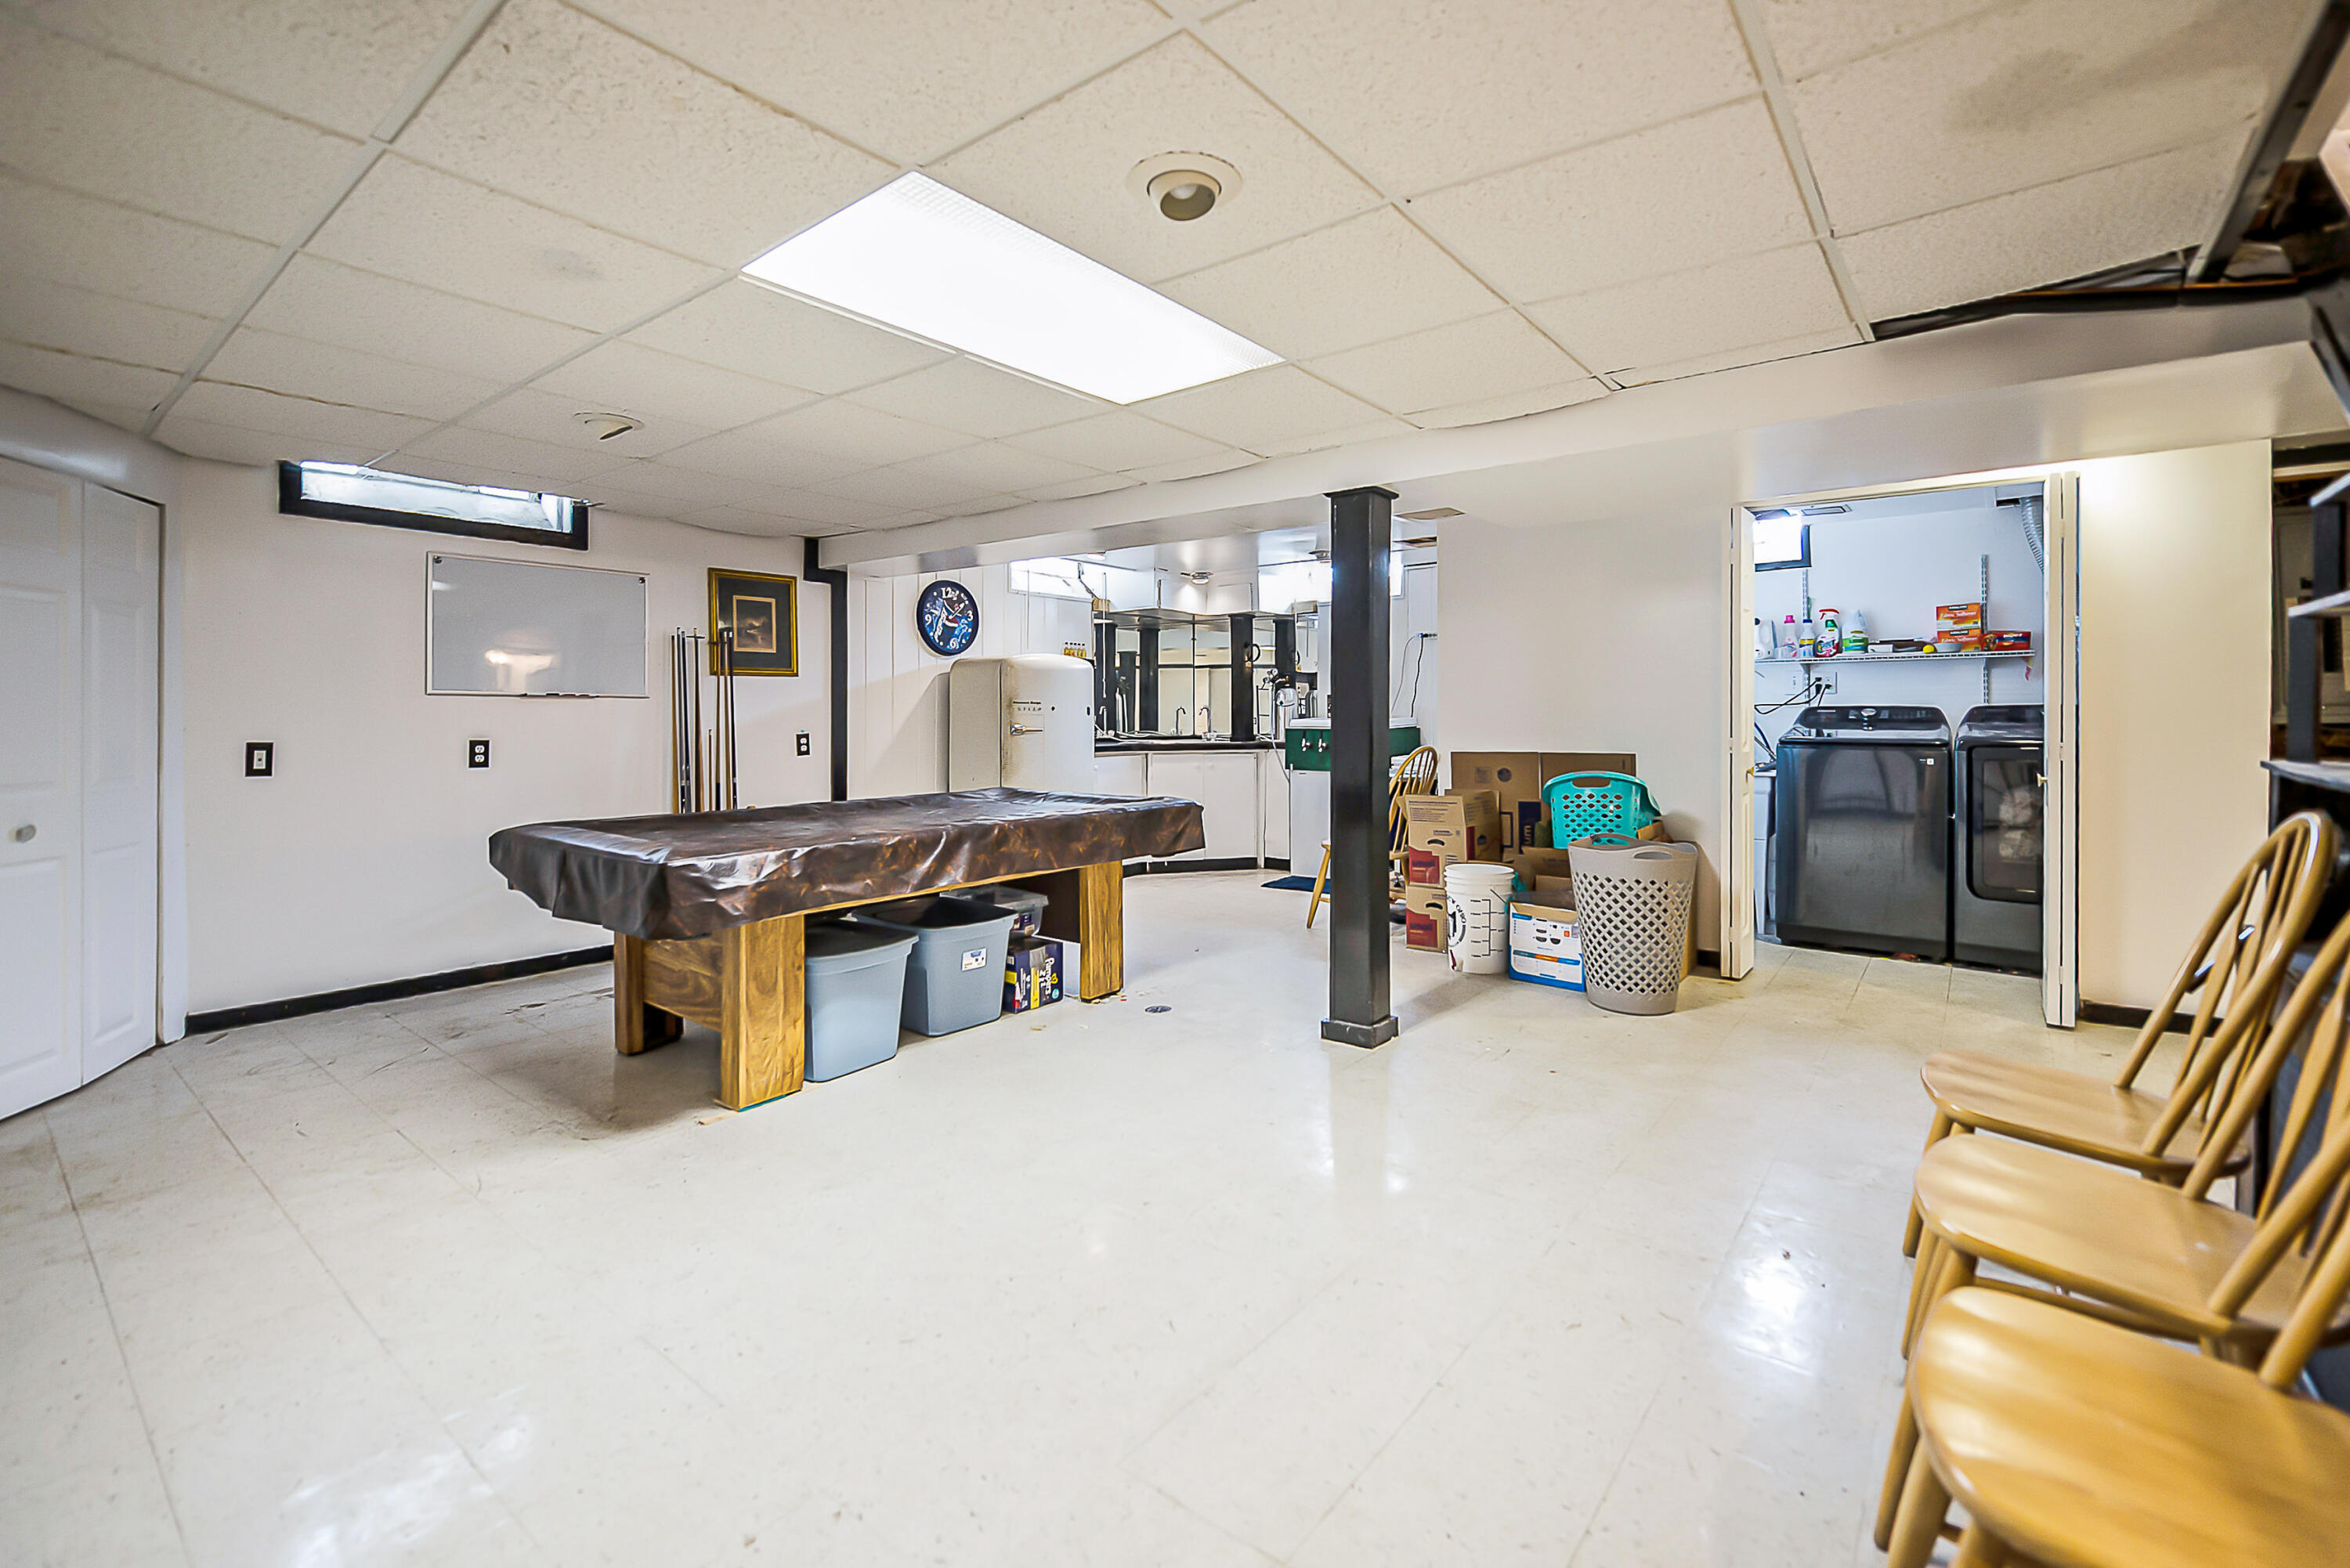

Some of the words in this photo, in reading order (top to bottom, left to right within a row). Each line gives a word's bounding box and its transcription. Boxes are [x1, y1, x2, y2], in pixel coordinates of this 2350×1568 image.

[941, 587, 953, 598] 12
[924, 614, 932, 626] 9
[967, 610, 973, 622] 3
[949, 638, 956, 648] 6
[1044, 957, 1055, 995] Pampers
